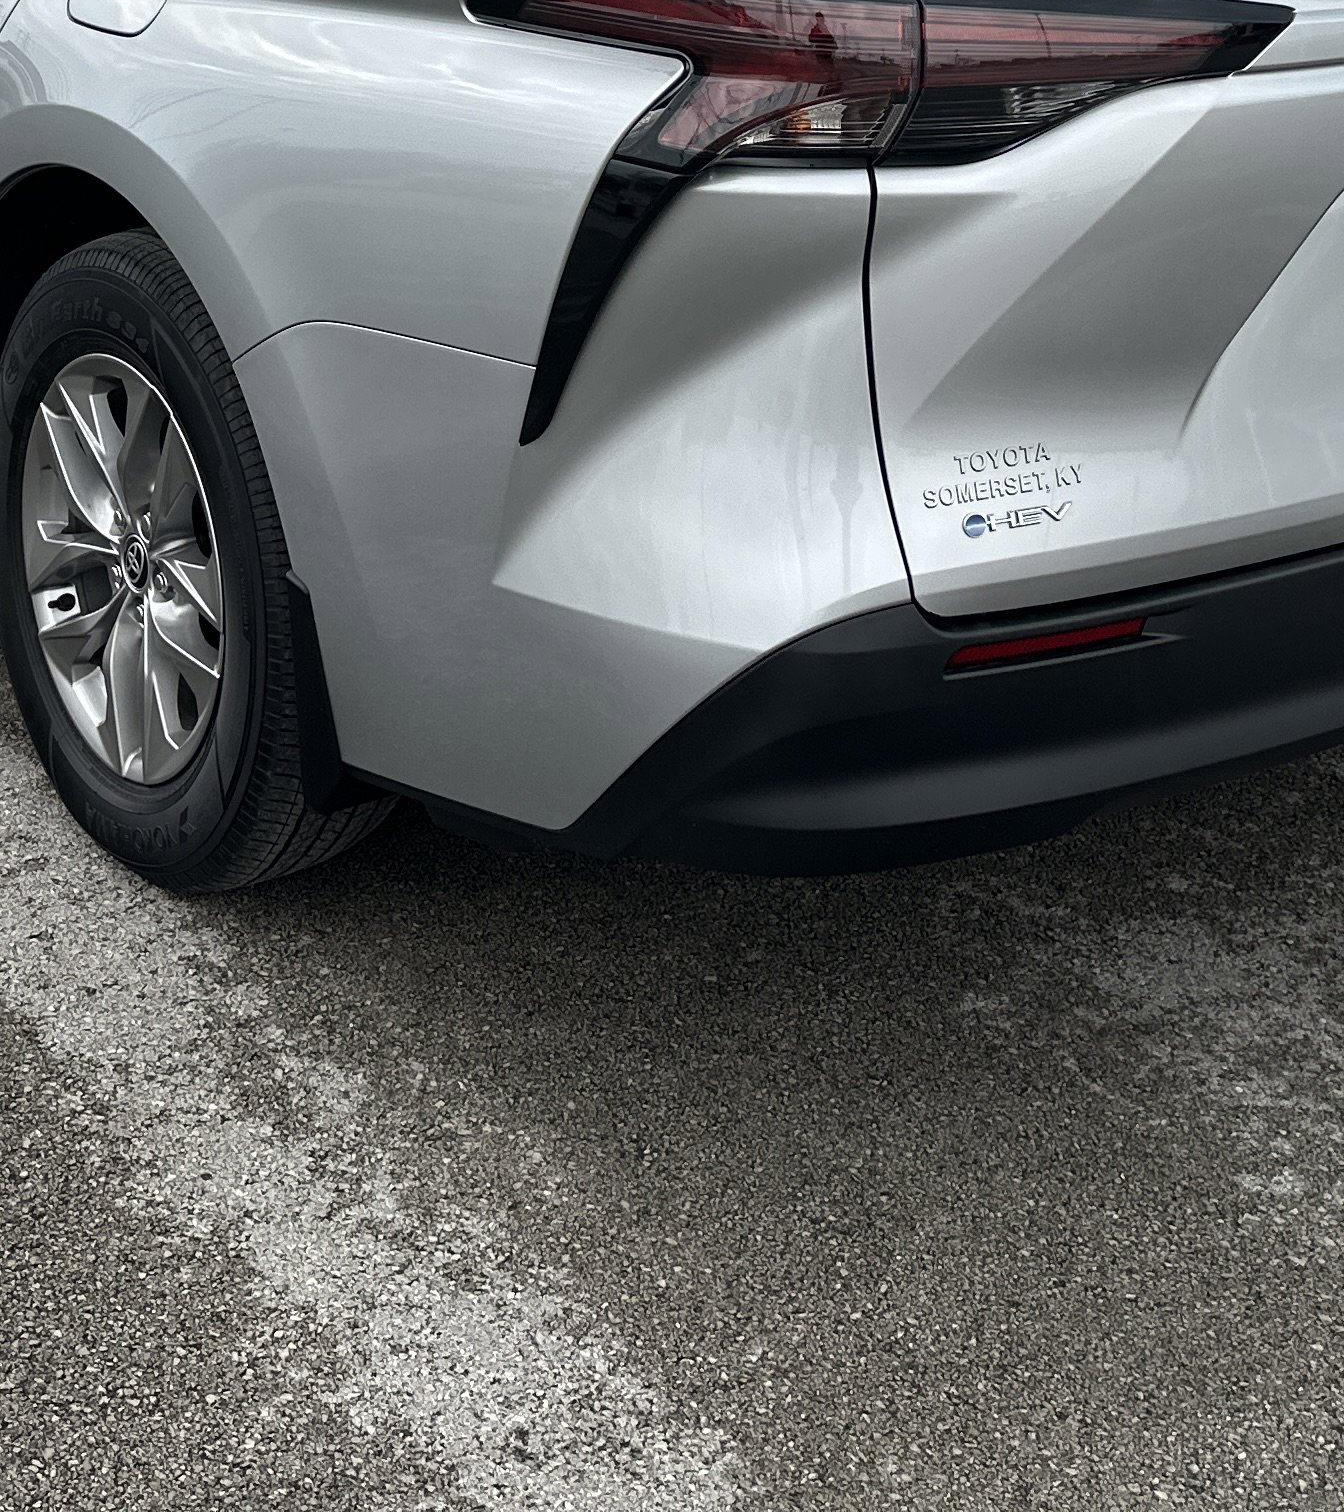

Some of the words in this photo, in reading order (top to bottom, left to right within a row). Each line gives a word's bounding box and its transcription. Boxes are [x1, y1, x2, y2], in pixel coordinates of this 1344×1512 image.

[953, 442, 1051, 475] TOYOTA
[922, 472, 1052, 509] SOMERSET,
[1055, 463, 1083, 488] KY
